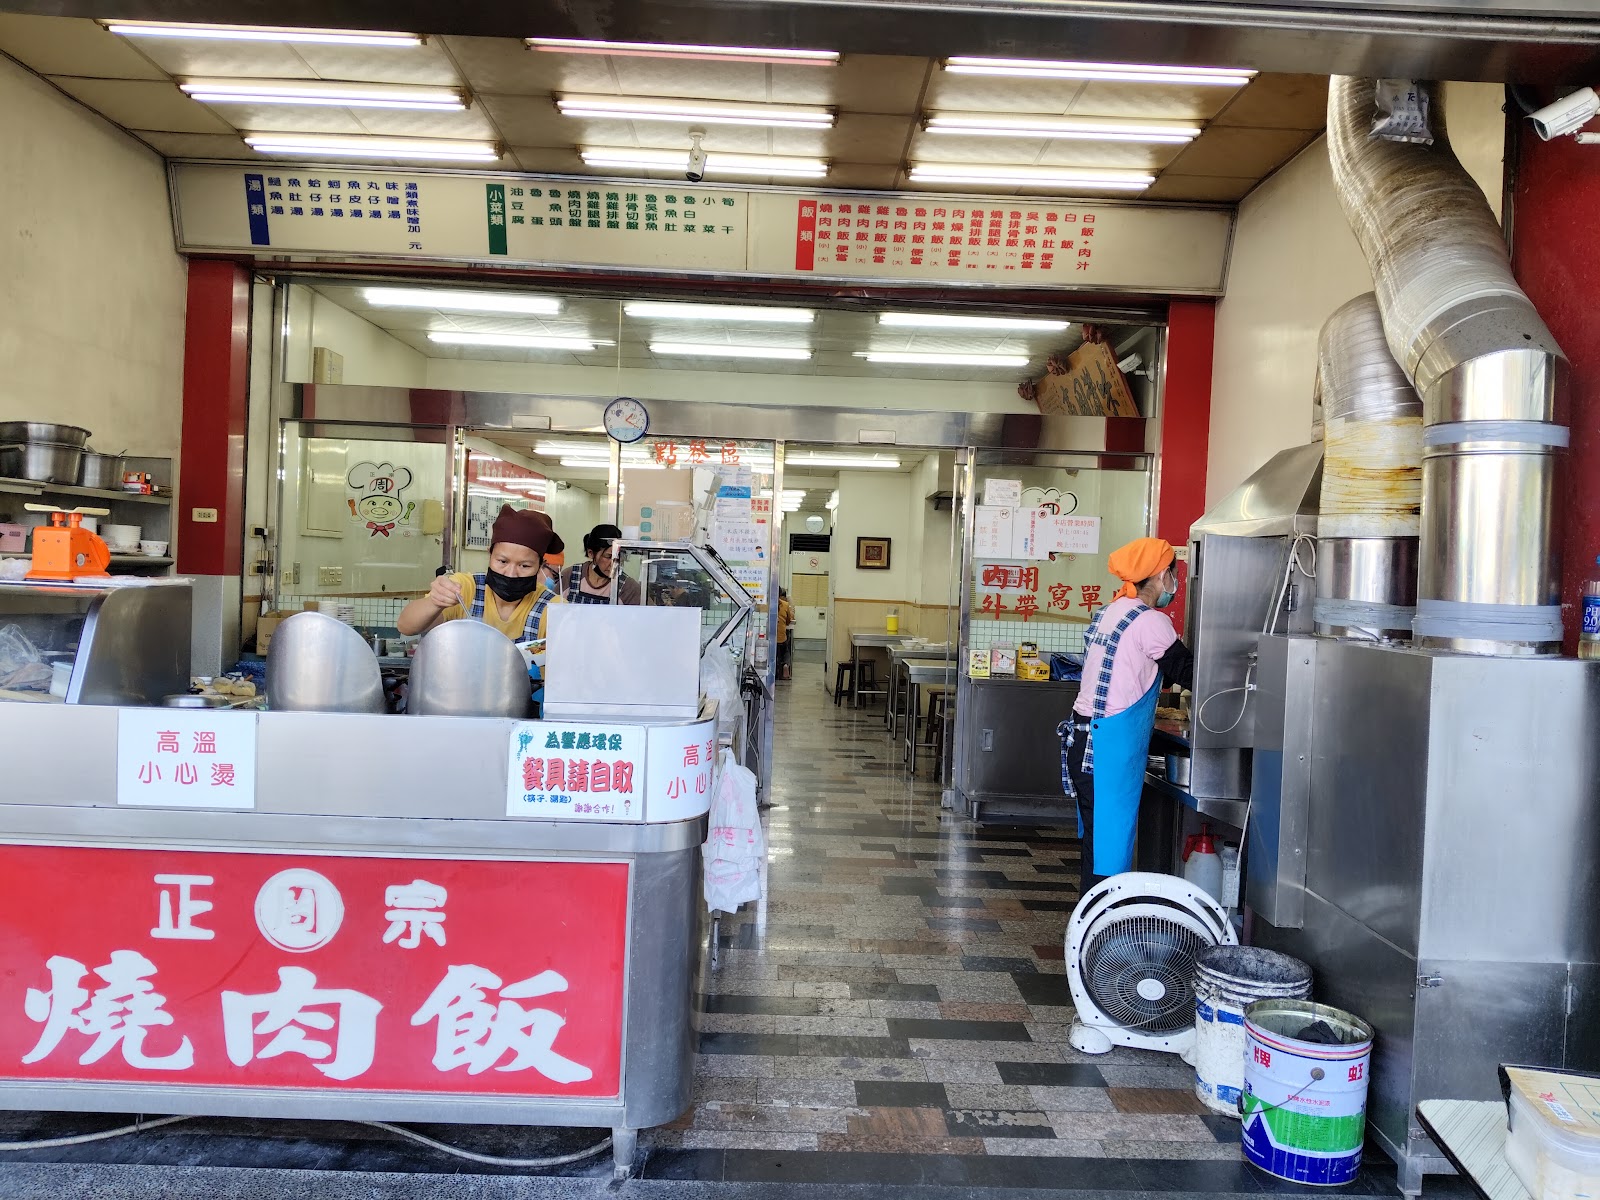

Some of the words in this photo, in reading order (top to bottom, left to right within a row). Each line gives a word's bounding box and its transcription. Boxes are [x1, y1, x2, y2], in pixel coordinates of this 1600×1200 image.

[248, 179, 265, 216] 湯類
[288, 178, 304, 216] 魚肚湯
[308, 178, 324, 216] 蛤仔湯
[328, 180, 344, 218] 蚵仔湯
[348, 180, 363, 218] 魚皮湯
[367, 181, 382, 219] 丸仔湯
[386, 182, 401, 220] 味噌湯
[490, 189, 504, 226] 小菜類
[510, 187, 525, 225] 油豆腐
[530, 188, 544, 226] 魯蛋
[548, 189, 563, 227] 魯魚頭
[568, 190, 582, 228] 燒肉切盤
[586, 190, 601, 229] 燒雞腿盤
[606, 192, 620, 230] 燒雞排盤
[625, 193, 639, 231] 排骨切盤
[644, 194, 658, 232] 魯吳郭魚
[664, 194, 678, 232] 魯魚肚
[683, 196, 696, 234] 魯白菜
[702, 196, 716, 234] 小菜
[800, 206, 815, 242] 飯類
[818, 203, 833, 240] 燒肉飯
[836, 204, 852, 262] 燒肉飯便當
[856, 204, 871, 242] 雞肉飯
[872, 205, 890, 264] 雞肉飯便當
[892, 206, 908, 244] 魯肉飯
[910, 207, 928, 265] 魯肉飯便當
[930, 208, 946, 244] 肉燥飯
[948, 209, 965, 266] 肉燥飯便當
[968, 210, 984, 246] 燒雞排飯
[987, 210, 1004, 247] 燒雞腿飯
[1006, 211, 1022, 248] 魯排骨飯
[1020, 212, 1040, 269] 吳郭魚便當
[1060, 213, 1077, 249] 白飯
[409, 242, 422, 250] 元
[1040, 212, 1059, 270] 魯魚肚便當
[654, 439, 740, 466] 點餐區
[982, 566, 1039, 592] 內用
[1048, 583, 1117, 612] 寫單
[980, 593, 1040, 622] 外帶
[1584, 616, 1598, 626] 9.0
[156, 730, 217, 754] 高溫
[544, 730, 622, 751] 為響應環保
[138, 760, 235, 786] 小心燙
[522, 756, 634, 794] 餐具請自取
[667, 765, 713, 799] 小心
[150, 873, 216, 940] 正
[382, 879, 448, 949] 宗
[21, 949, 593, 1084] 燒肉飯
